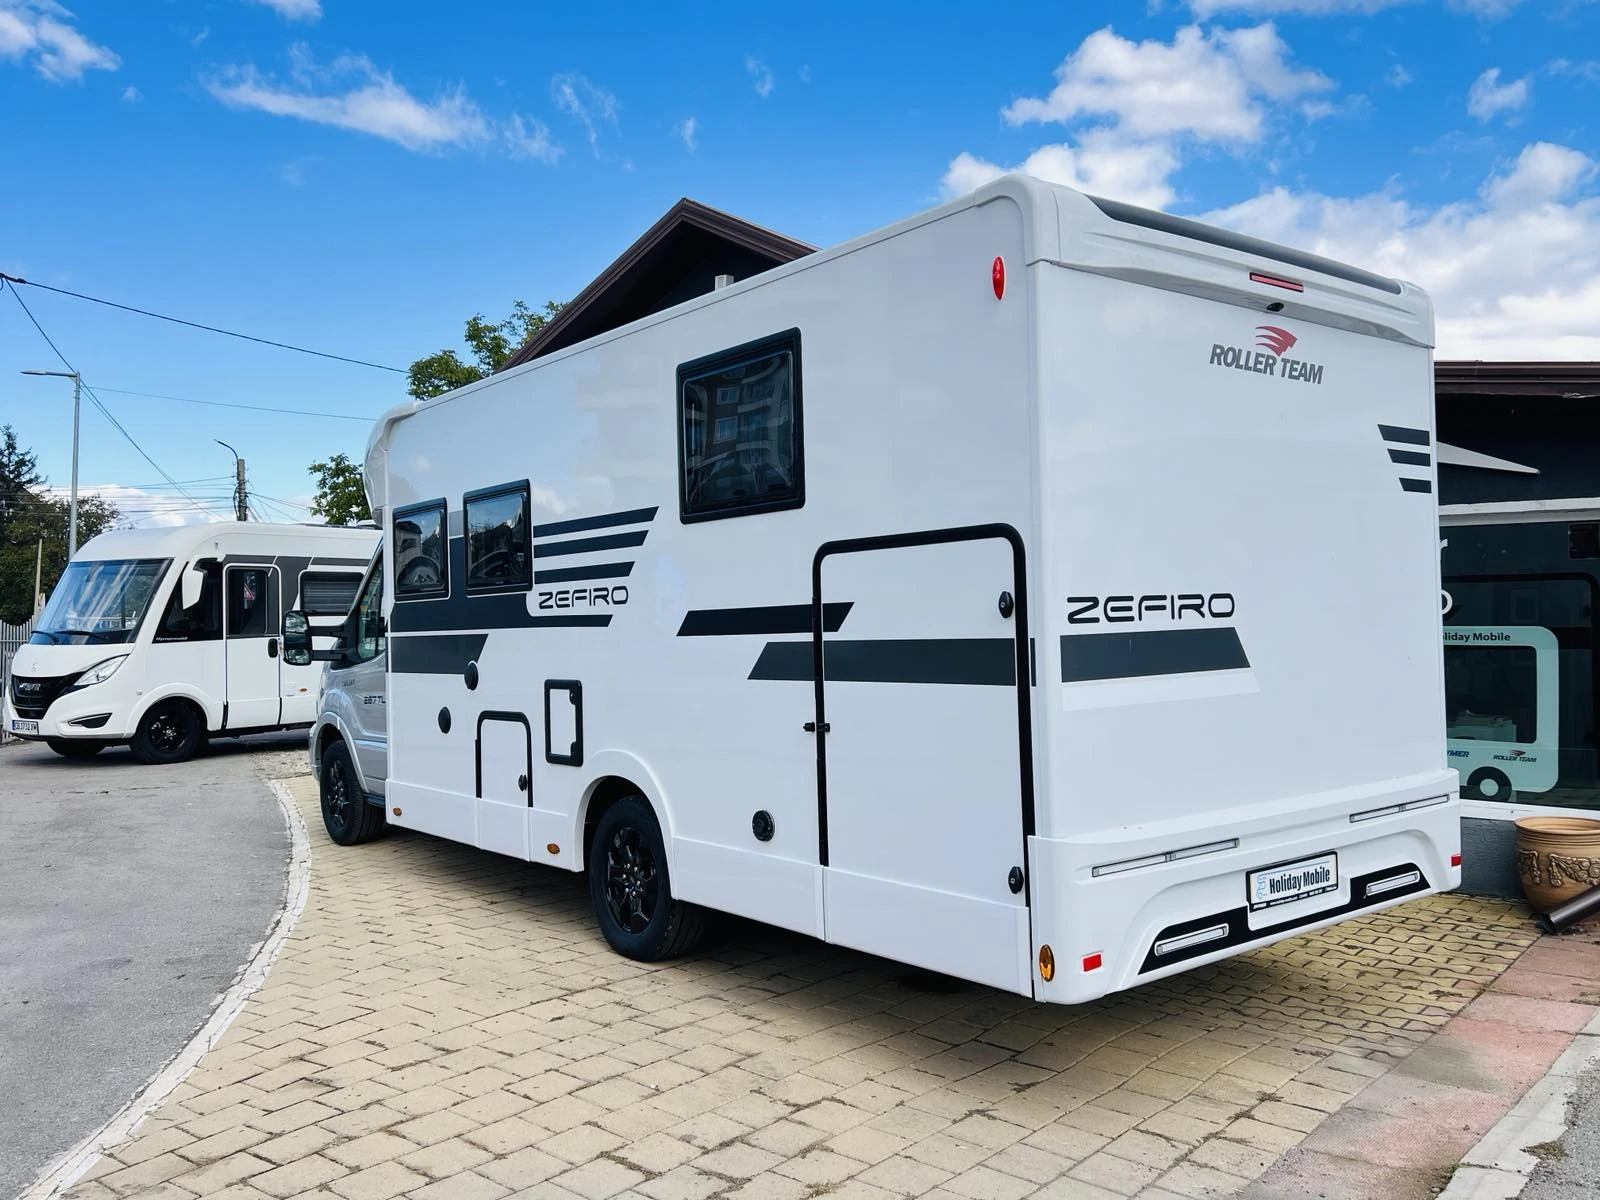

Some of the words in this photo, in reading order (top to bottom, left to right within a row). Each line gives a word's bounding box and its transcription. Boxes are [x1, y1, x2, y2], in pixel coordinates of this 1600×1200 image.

[1209, 343, 1278, 376] ROLLER
[1281, 357, 1324, 385] TEAM
[538, 585, 629, 610] ZEFIRO
[1066, 592, 1236, 625] ZEFIRO
[1443, 632, 1471, 643] liday
[1472, 632, 1511, 641] Mobile
[1447, 750, 1470, 758] YMER
[1493, 754, 1518, 762] ROLLER
[1269, 873, 1302, 894] Holiday
[1303, 866, 1330, 887] Mobile
